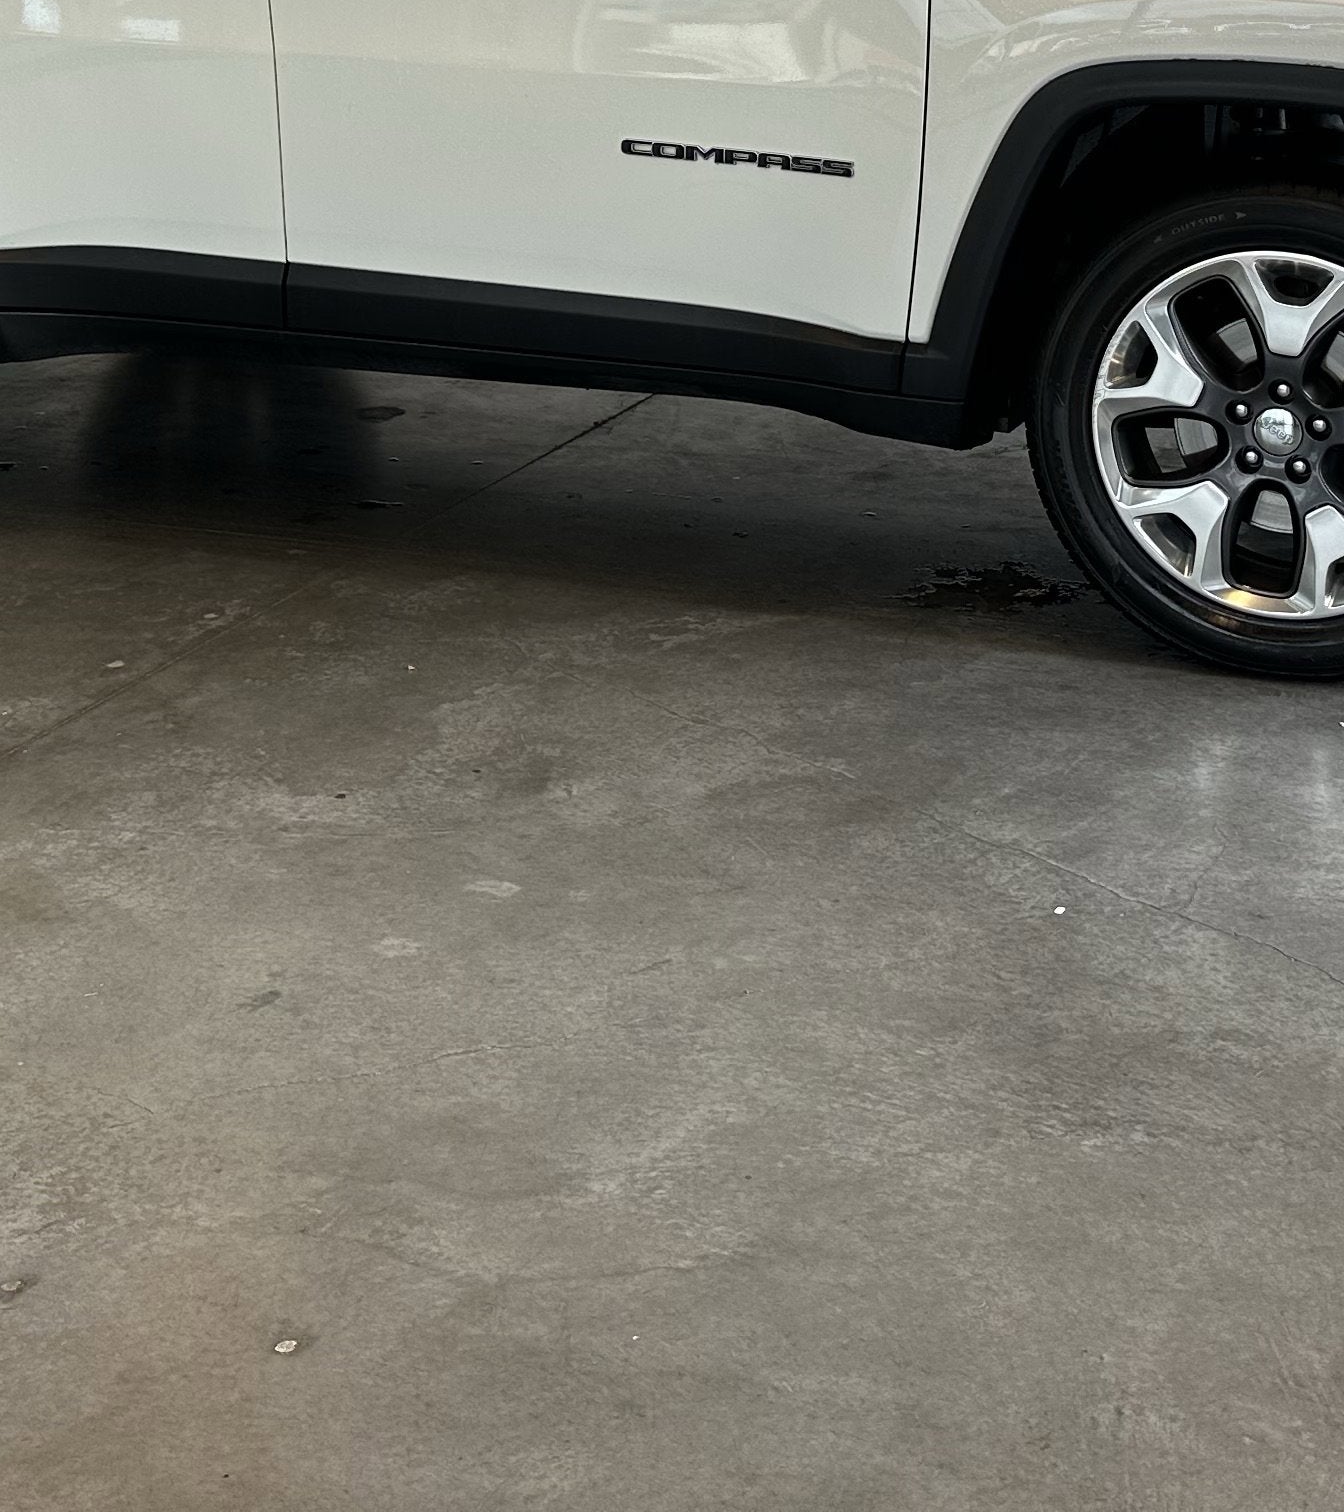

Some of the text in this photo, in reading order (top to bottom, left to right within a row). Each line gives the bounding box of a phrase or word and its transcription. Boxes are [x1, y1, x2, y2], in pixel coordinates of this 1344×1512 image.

[620, 138, 855, 178] COMPASS
[1171, 214, 1225, 235] OUTSIDE
[1260, 417, 1295, 446] Jeep
